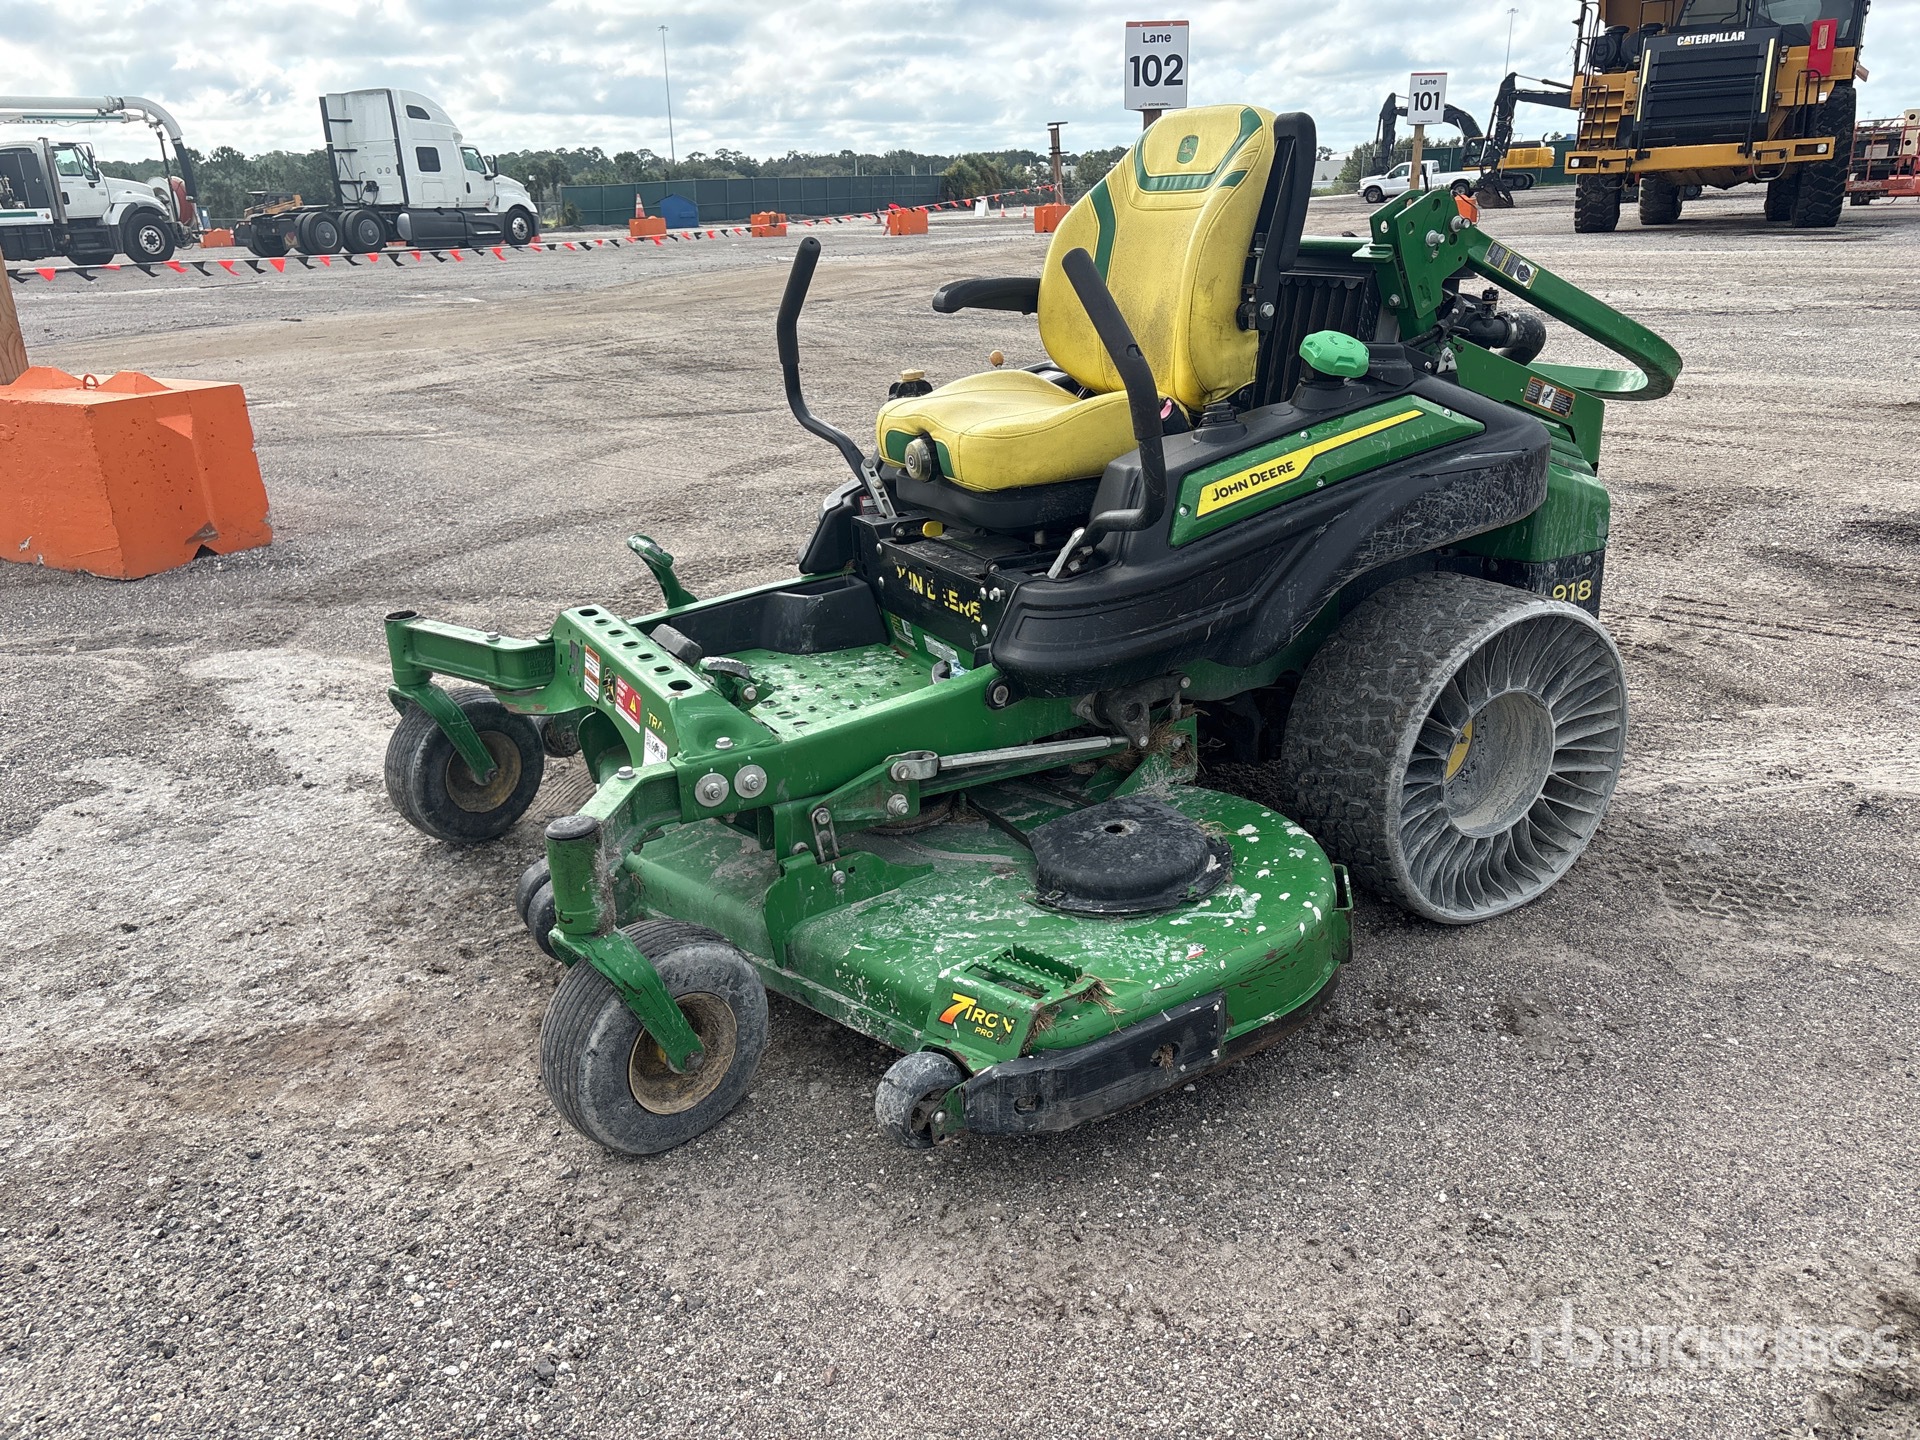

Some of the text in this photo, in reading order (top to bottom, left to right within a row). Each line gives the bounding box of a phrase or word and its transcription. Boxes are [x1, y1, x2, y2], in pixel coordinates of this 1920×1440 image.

[1142, 31, 1172, 44] Lane
[1676, 31, 1746, 46] CATERPILLAR
[1129, 53, 1184, 88] 102
[1419, 78, 1438, 86] Lane
[1413, 91, 1441, 111] 101
[1212, 460, 1296, 502] JOHN DEERE
[1552, 579, 1592, 602] 918
[974, 1026, 994, 1039] PRO
